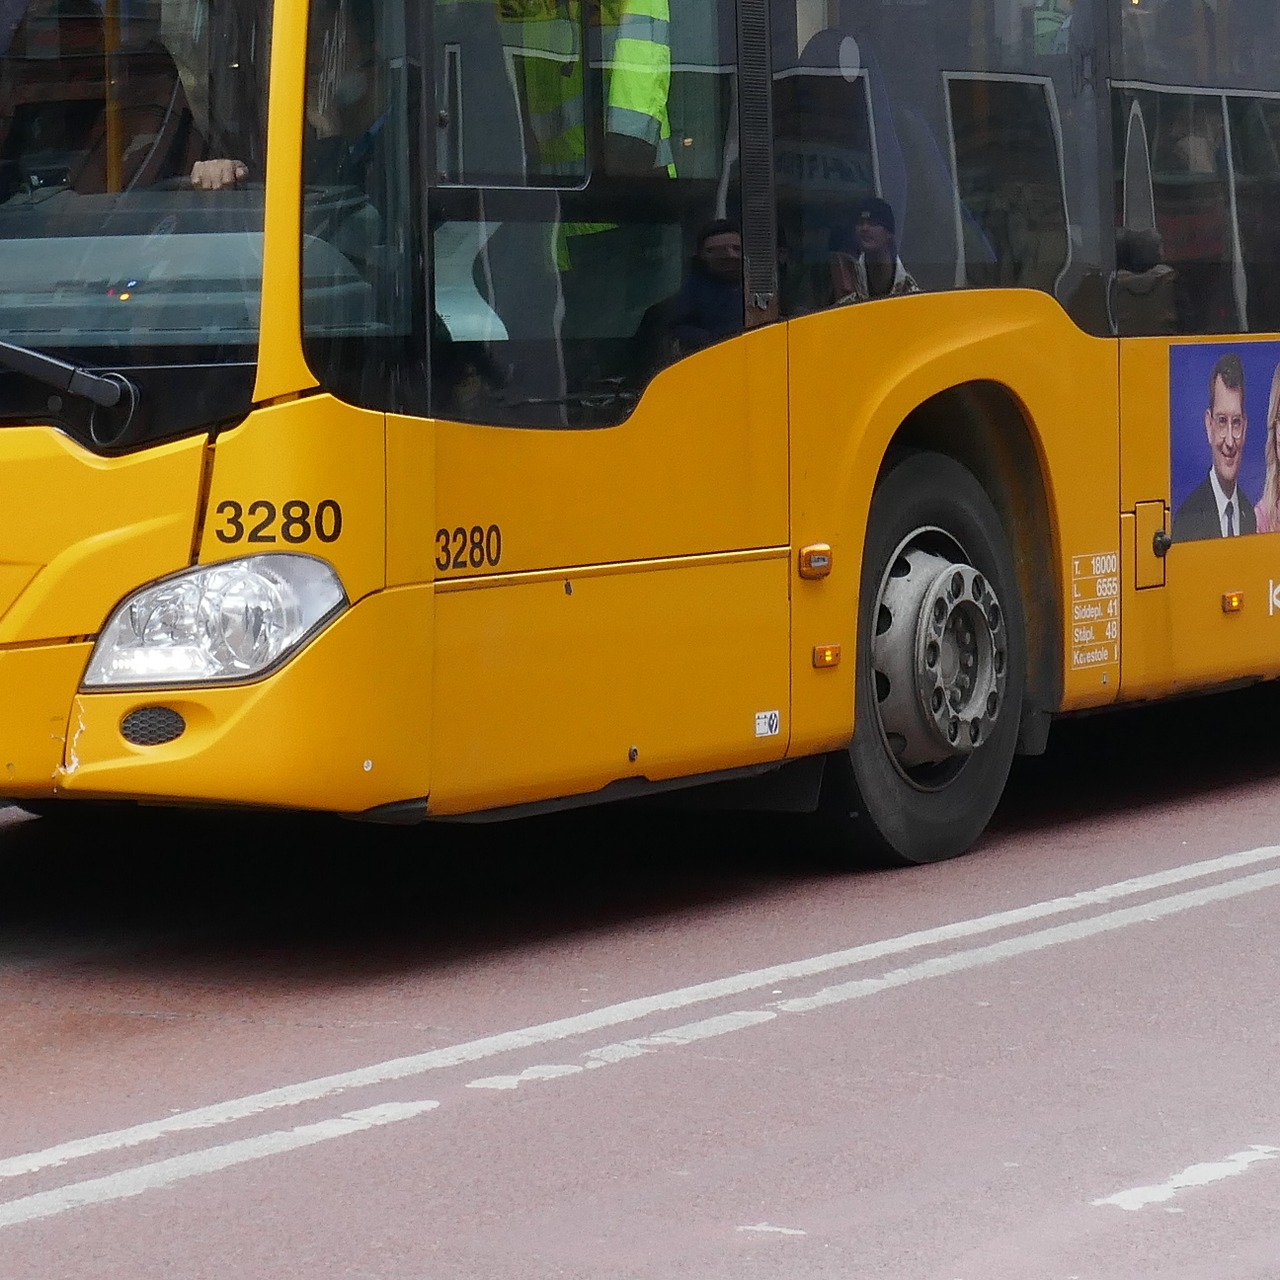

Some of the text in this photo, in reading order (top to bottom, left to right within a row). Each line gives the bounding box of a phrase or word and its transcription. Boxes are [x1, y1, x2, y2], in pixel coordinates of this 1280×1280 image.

[215, 499, 343, 544] 3280
[435, 524, 502, 571] 3280
[1091, 555, 1117, 575] 18000
[1096, 577, 1118, 597] 6555
[1107, 598, 1118, 616] 41
[1105, 621, 1117, 639] 48
